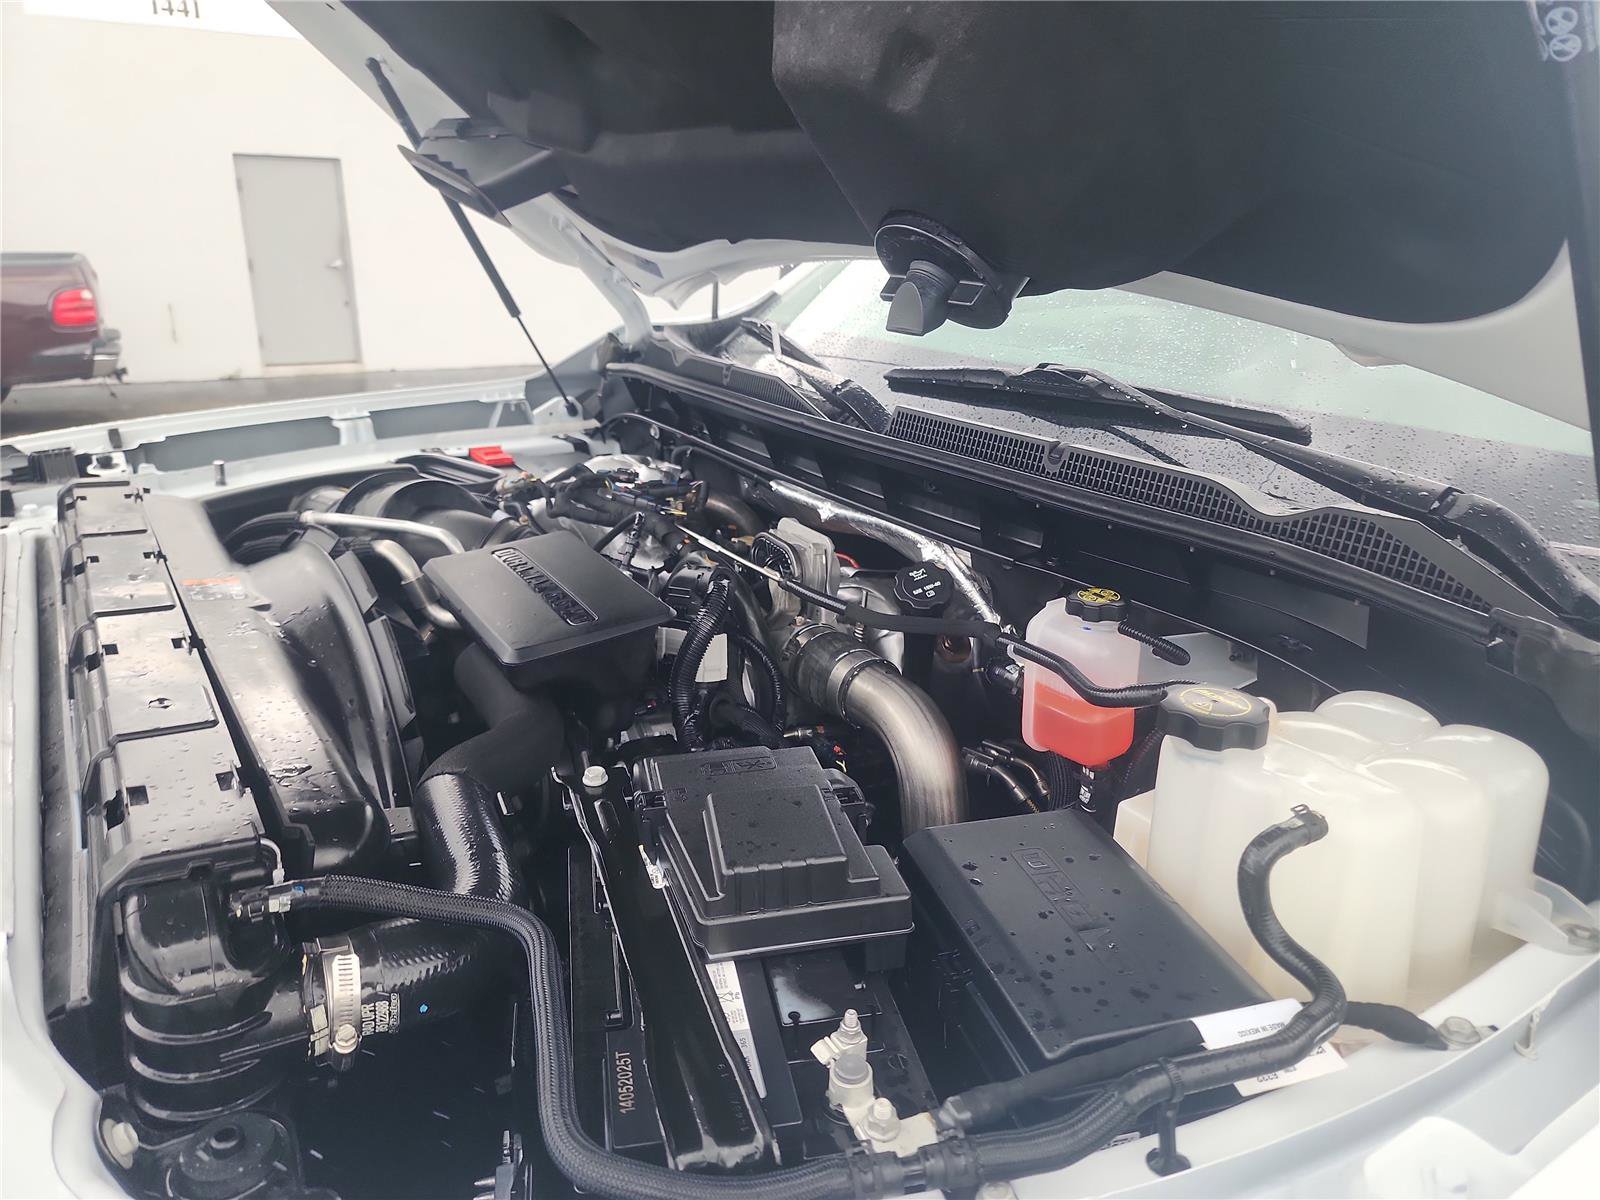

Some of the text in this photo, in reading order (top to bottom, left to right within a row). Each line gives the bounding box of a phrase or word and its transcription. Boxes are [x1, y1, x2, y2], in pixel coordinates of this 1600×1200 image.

[151, 0, 200, 19] 1441
[361, 1003, 375, 1036] RAD UPR
[615, 1051, 636, 1114] 14052025T
